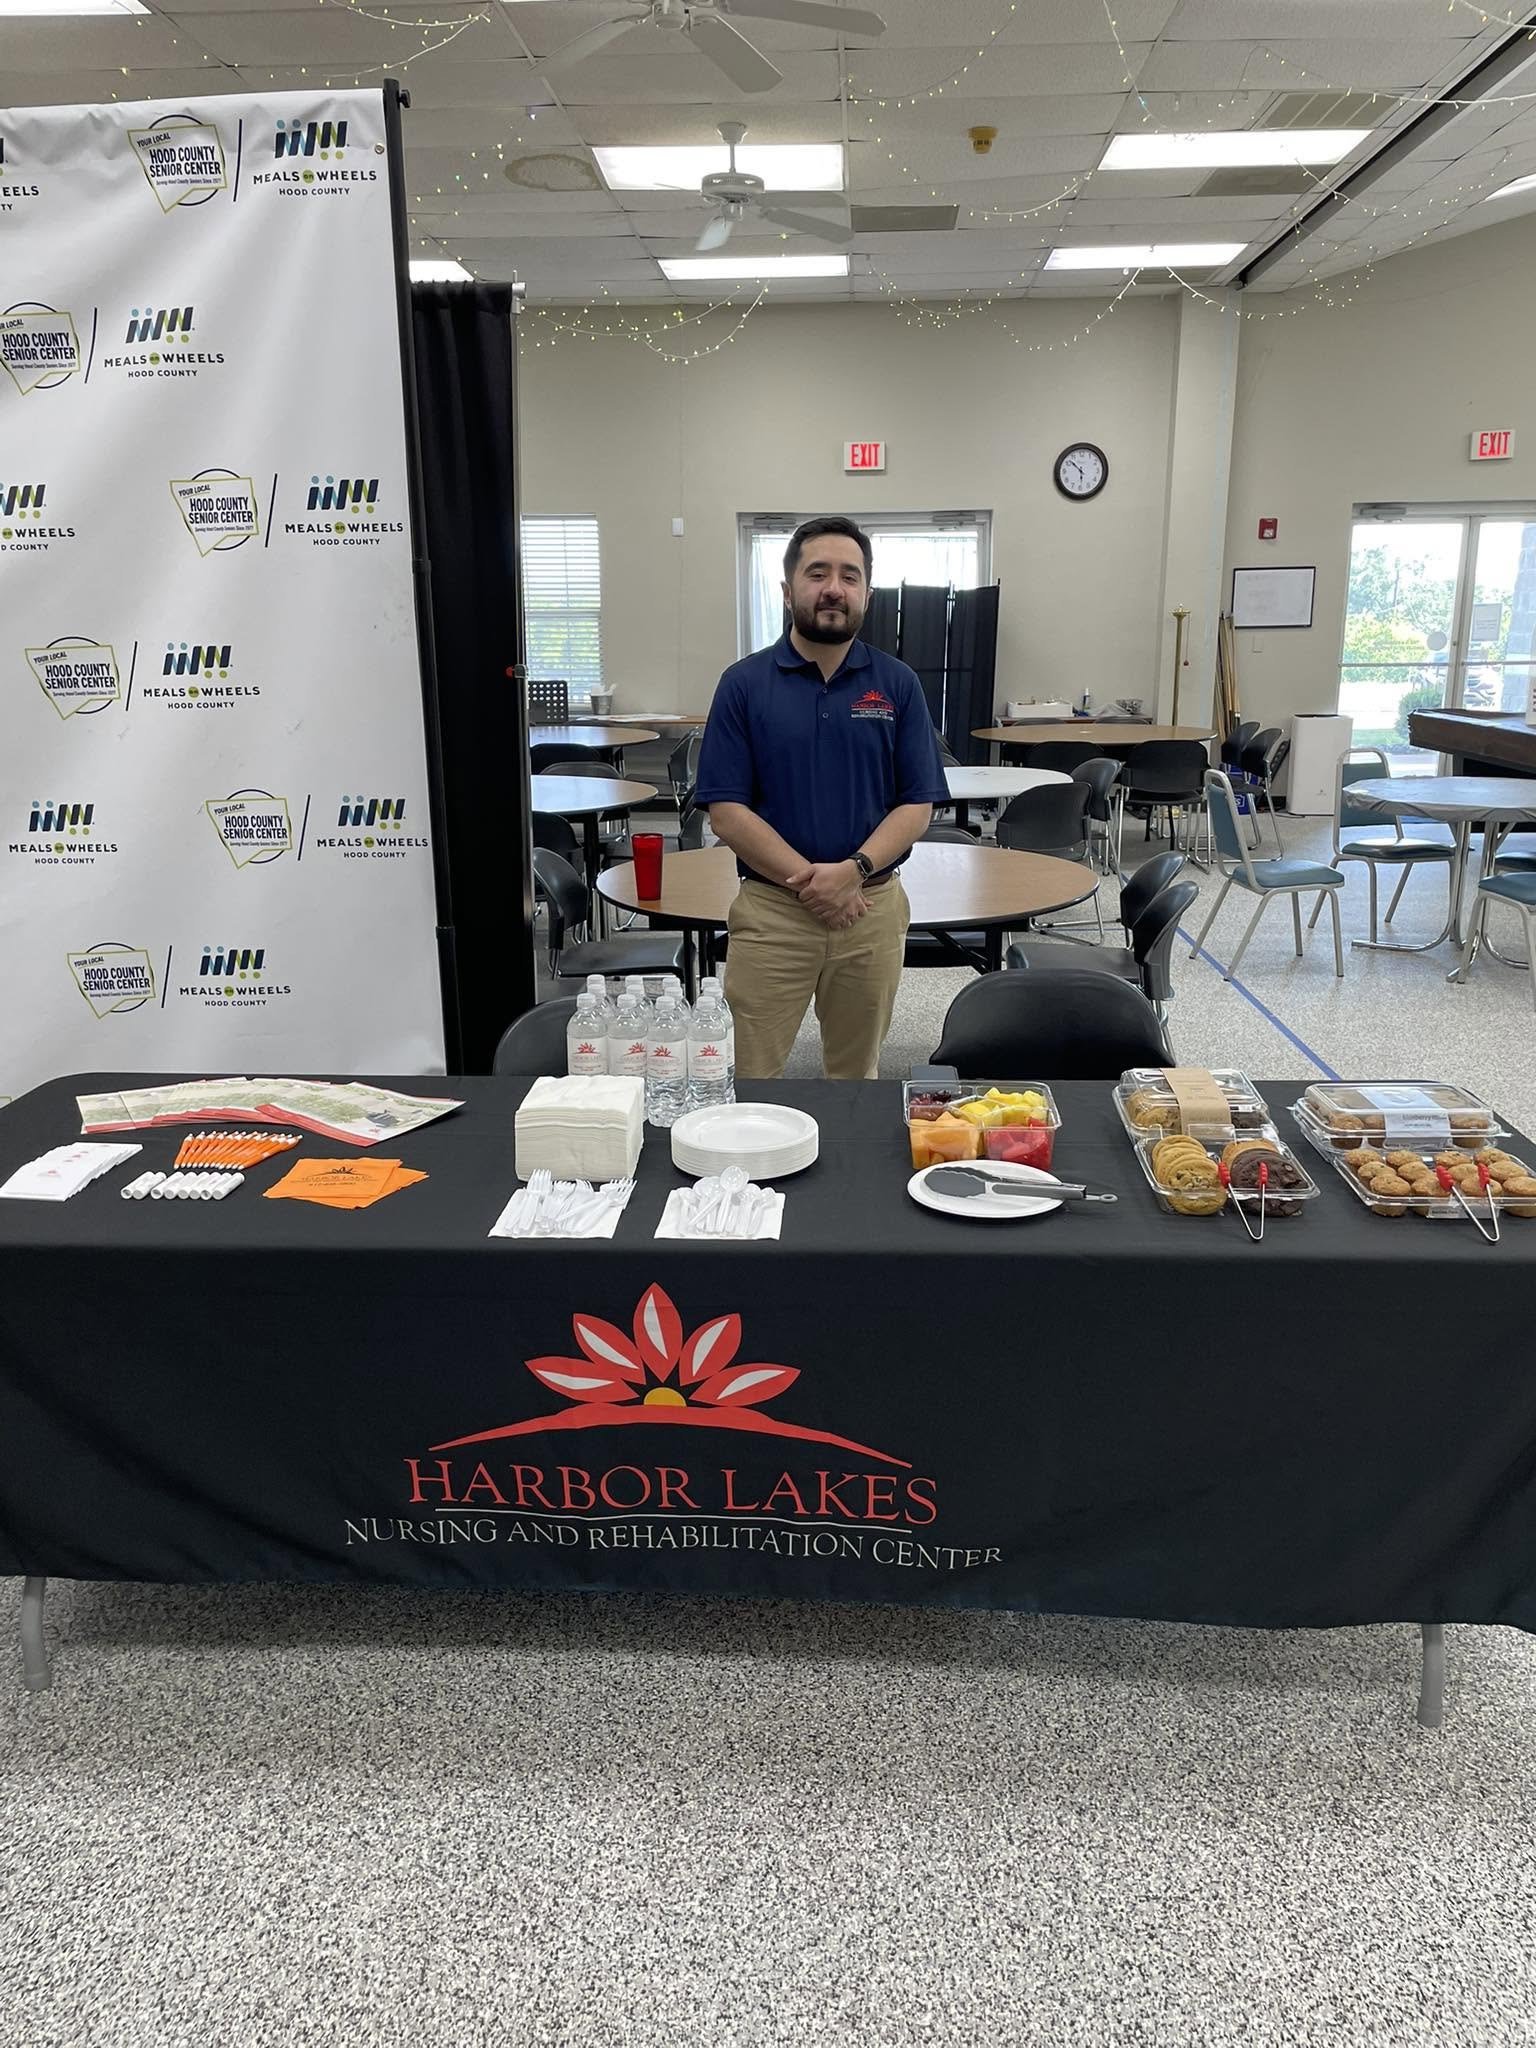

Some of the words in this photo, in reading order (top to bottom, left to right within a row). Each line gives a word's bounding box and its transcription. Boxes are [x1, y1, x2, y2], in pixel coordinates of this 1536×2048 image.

[153, 133, 171, 144] LOCAL
[149, 148, 176, 164] HOOD
[178, 146, 215, 162] COUNTY
[149, 164, 182, 178] SENIOR
[184, 161, 221, 175] CENTER
[253, 171, 300, 184] MEALS
[316, 170, 377, 181] WHEELS
[2, 185, 39, 196] EELS
[279, 188, 308, 196] HOOD
[311, 187, 350, 195] COUNTY
[6, 319, 24, 329] LOCAL
[2, 333, 30, 348] HOOD
[31, 332, 69, 347] COUNTY
[3, 348, 39, 361] SENIOR
[40, 347, 76, 360] CENTER
[104, 355, 147, 368] MEALS
[162, 353, 225, 363] WHEELS
[128, 370, 154, 378] HOOD
[157, 369, 198, 377] COUNTY
[1479, 431, 1510, 456] EXIT
[851, 443, 880, 467] EXIT
[194, 484, 211, 494] LOCAL
[189, 498, 214, 511] HOOD
[216, 497, 248, 511] COUNTY
[188, 512, 219, 524] SENIOR
[220, 511, 254, 523] CENTER
[15, 528, 75, 538] WHEELS
[285, 524, 332, 533] MEALS
[348, 523, 403, 532] WHEELS
[49, 651, 67, 660] LOCAL
[45, 665, 72, 677] HOOD
[74, 663, 110, 677] COUNTY
[45, 678, 80, 689] SENIOR
[81, 677, 116, 688] CENTER
[143, 688, 186, 697] MEALS
[201, 687, 260, 696] WHEELS
[229, 803, 245, 812] LOCAL
[224, 816, 249, 828] HOOD
[251, 815, 283, 828] COUNTY
[223, 828, 254, 839] SENIOR
[256, 828, 288, 839] CENTER
[9, 844, 52, 853] MEALS
[66, 844, 118, 852] WHEELS
[317, 838, 362, 847] MEALS
[376, 838, 428, 847] WHEELS
[88, 956, 104, 964] LOCAL
[84, 968, 109, 980] HOOD
[110, 966, 145, 979] COUNTY
[83, 980, 115, 991] SENIOR
[116, 978, 150, 990] CENTER
[180, 987, 222, 995] MEALS
[236, 986, 291, 995] WHEELS
[403, 1458, 701, 1509] HARBOR
[720, 1468, 937, 1526] LAKES
[344, 1517, 498, 1545] NURSING
[507, 1521, 579, 1546] AND
[588, 1524, 863, 1560] REHABILITATION
[872, 1537, 1003, 1570] CENTER
